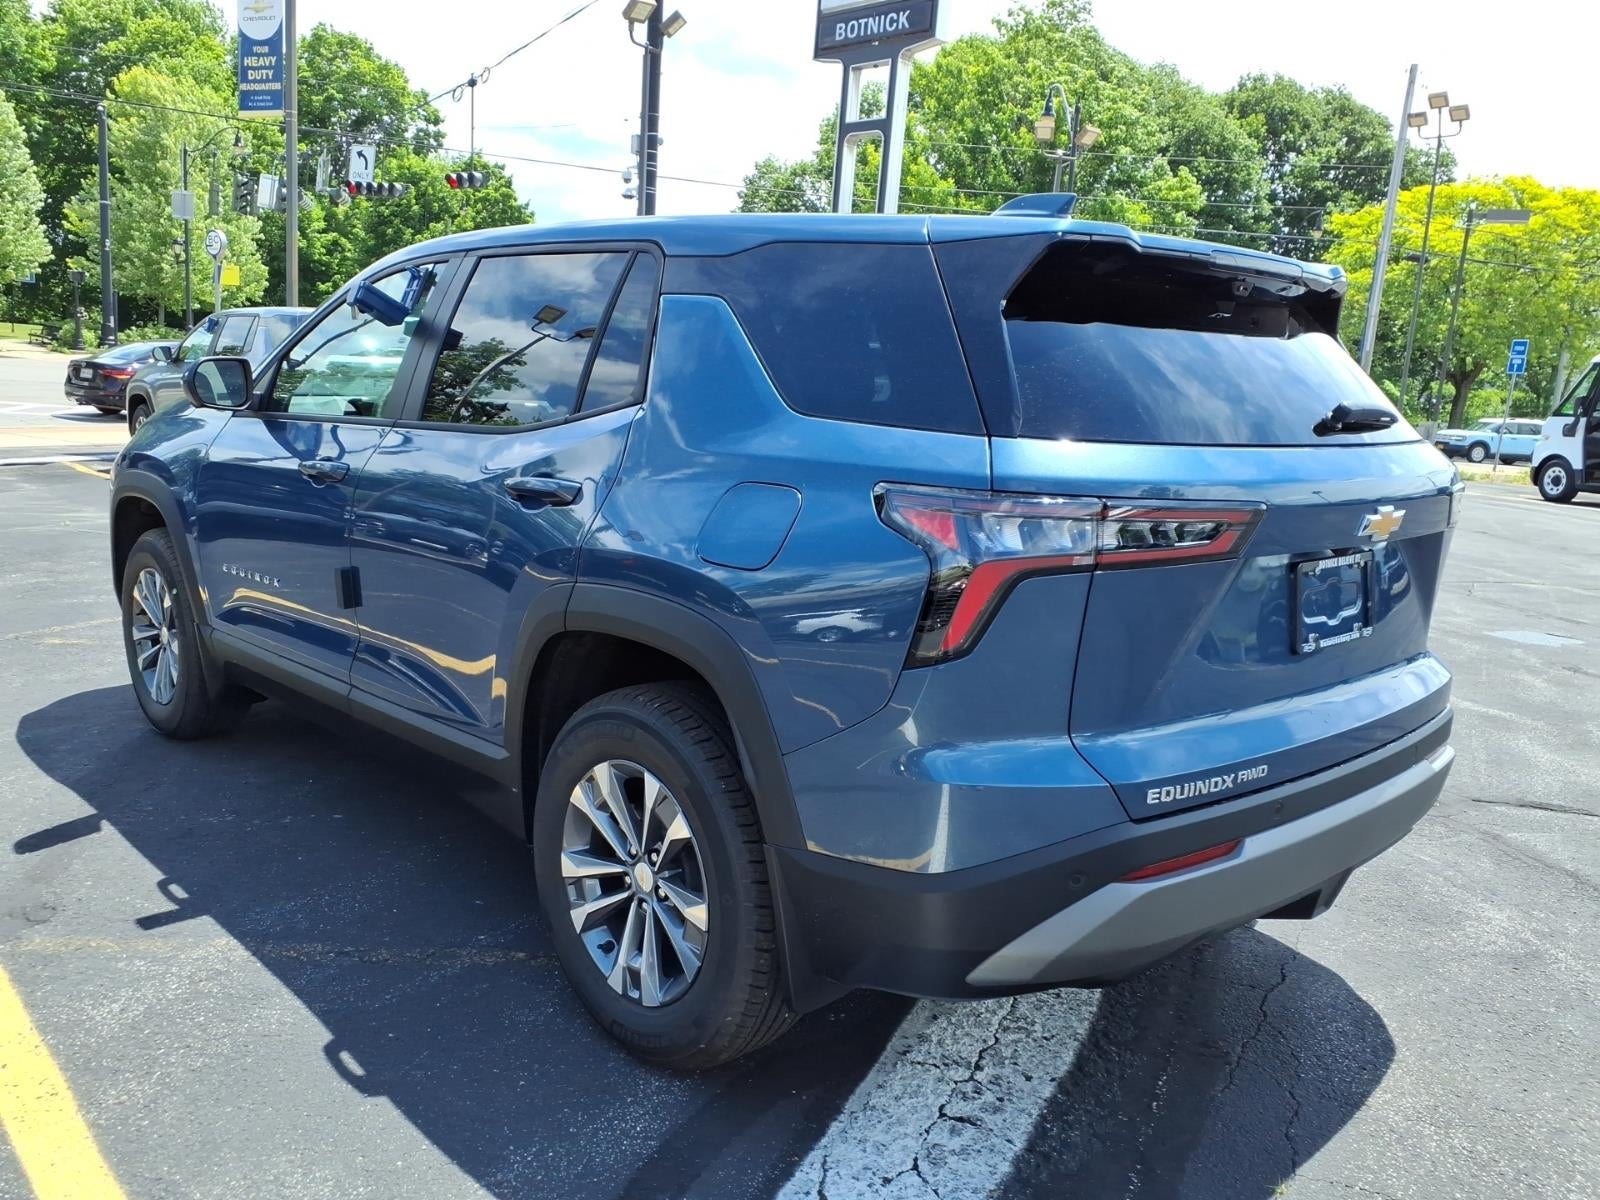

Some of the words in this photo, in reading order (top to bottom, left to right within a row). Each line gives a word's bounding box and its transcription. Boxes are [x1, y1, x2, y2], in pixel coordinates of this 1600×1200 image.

[835, 10, 911, 41] BOTNICK
[252, 45, 269, 53] YOUR
[244, 56, 277, 67] HEAVY
[247, 69, 274, 80] DUTY
[239, 82, 282, 91] HEADQUARTERS
[352, 171, 371, 180] ONLY
[222, 563, 281, 587] EQUINOX
[1146, 773, 1235, 805] EQUINOX
[1237, 765, 1268, 783] AWD
